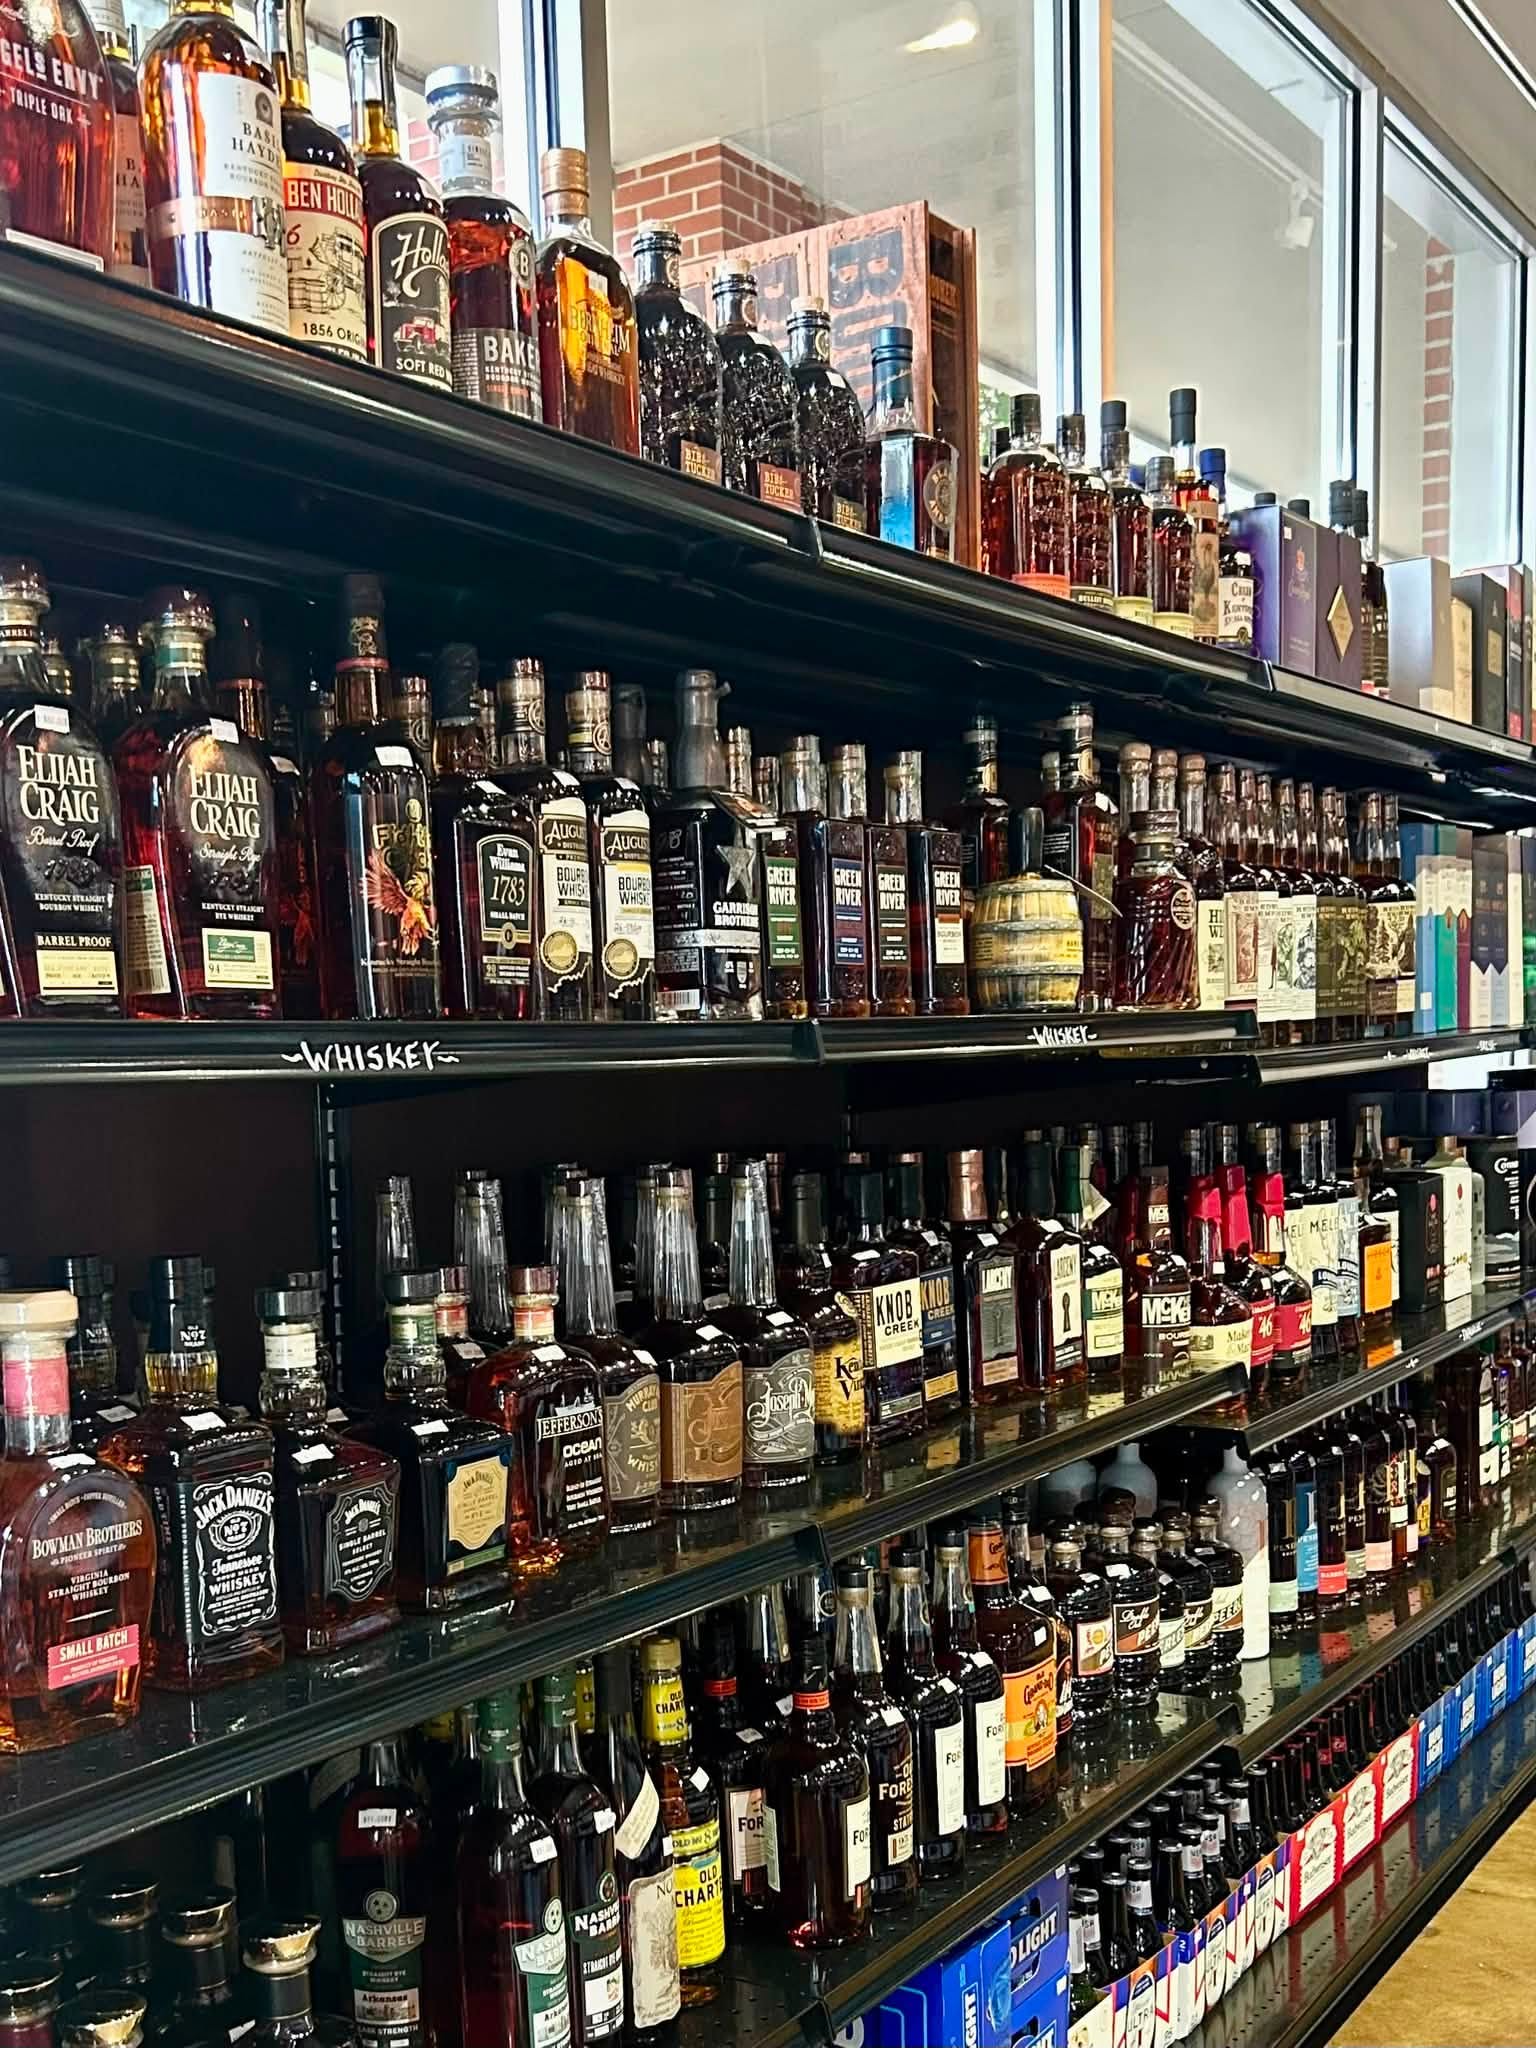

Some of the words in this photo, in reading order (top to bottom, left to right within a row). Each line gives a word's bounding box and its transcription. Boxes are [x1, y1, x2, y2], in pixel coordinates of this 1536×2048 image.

[52, 56, 101, 100] ENVY
[10, 86, 48, 116] TRIPLE
[51, 103, 74, 125] OAK
[243, 122, 280, 150] BASI
[288, 181, 321, 208] BEN
[303, 322, 333, 337] 1856
[396, 357, 426, 372] SOFT
[429, 361, 445, 377] RED
[16, 744, 98, 796] ELIJAH
[189, 764, 260, 810] ELIJAH
[20, 782, 101, 826] CRAIG
[190, 799, 260, 841] CRAIG
[766, 866, 796, 886] GREEN
[834, 868, 862, 886] GREEN
[878, 873, 905, 891] GREEN
[934, 871, 960, 888] GREEN
[490, 875, 526, 906] 1783
[769, 886, 796, 906] RIVER
[836, 887, 862, 907] RIVER
[880, 891, 906, 910] RIVER
[936, 888, 961, 907] RIVER
[712, 901, 758, 916] GARRISON
[714, 915, 759, 928] BROTHERS
[37, 934, 77, 948] BARREL
[79, 935, 112, 948] PROOF
[301, 1040, 440, 1072] WHISKEY
[921, 1277, 951, 1311] KNOB
[876, 1289, 912, 1326] KNOB
[884, 1318, 920, 1337] CREEK
[564, 1458, 582, 1468] AGED
[193, 1492, 227, 1529] JACK
[225, 1486, 275, 1516] DANIEL'S
[32, 1531, 84, 1560] BOWMAN
[85, 1520, 142, 1547] BROTHERS
[211, 1555, 263, 1576] Tennessee
[48, 1581, 90, 1600] STRAIGHT
[92, 1572, 130, 1588] BOURBON
[71, 1569, 109, 1584] VIRGINIA
[208, 1571, 267, 1597] WHISKEY
[72, 1586, 109, 1602] WHISKEY
[59, 1641, 94, 1662] SMALL
[96, 1629, 129, 1652] BATCH
[699, 1867, 718, 1884] OLD
[346, 1921, 423, 1938] NASHVILLE
[1018, 1911, 1058, 1964] LIGHT
[355, 1935, 415, 1948] BARREL
